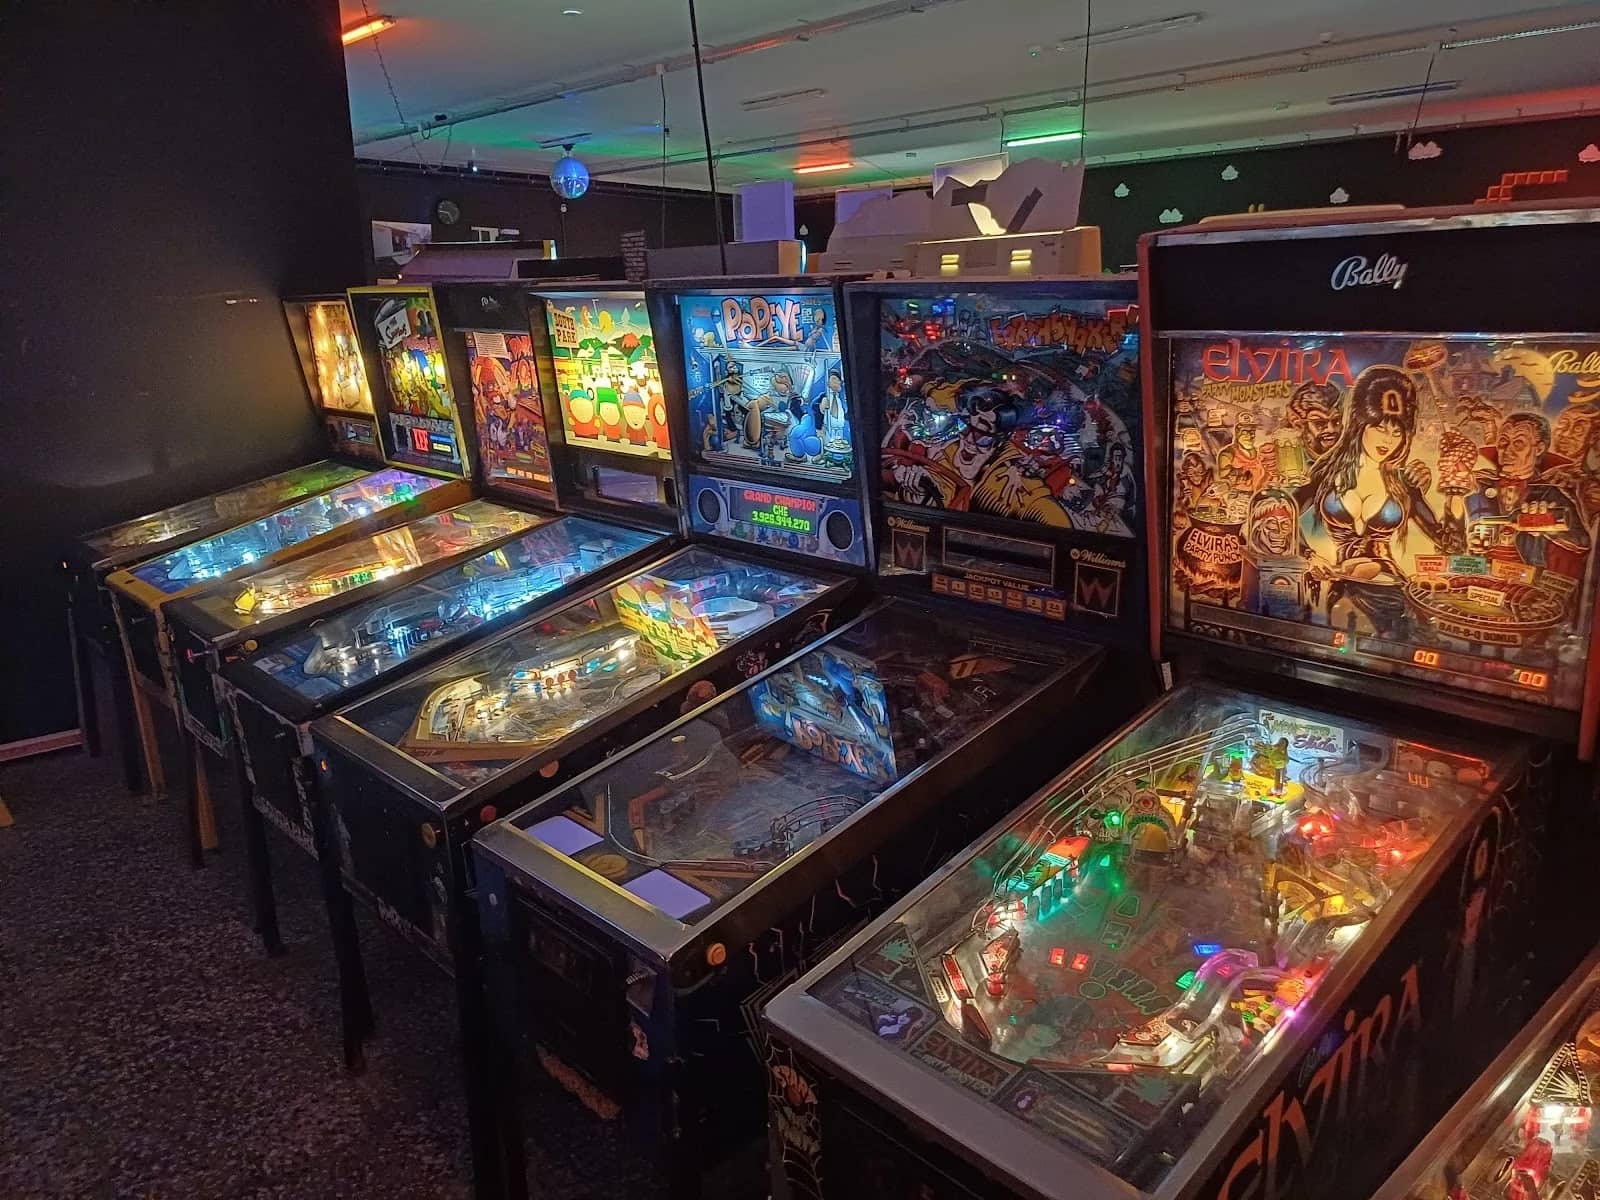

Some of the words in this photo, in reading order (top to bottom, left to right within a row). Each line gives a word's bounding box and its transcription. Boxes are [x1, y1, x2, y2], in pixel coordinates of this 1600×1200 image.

[1331, 252, 1408, 290] Bally
[554, 312, 575, 331] SOUTH
[720, 296, 804, 343] POPEYE
[556, 328, 577, 344] PARK
[1548, 349, 1600, 375] Ball
[1200, 381, 1232, 399] PARTY
[1231, 379, 1292, 403] MONSTERS
[743, 489, 772, 504] GRAND
[1080, 549, 1127, 568] Williams
[1185, 543, 1212, 560] PARTY
[963, 571, 1001, 585] JACKPOT
[1002, 579, 1030, 591] VALUE
[1469, 591, 1500, 604] SPECIAL
[1482, 631, 1518, 644] BONUS
